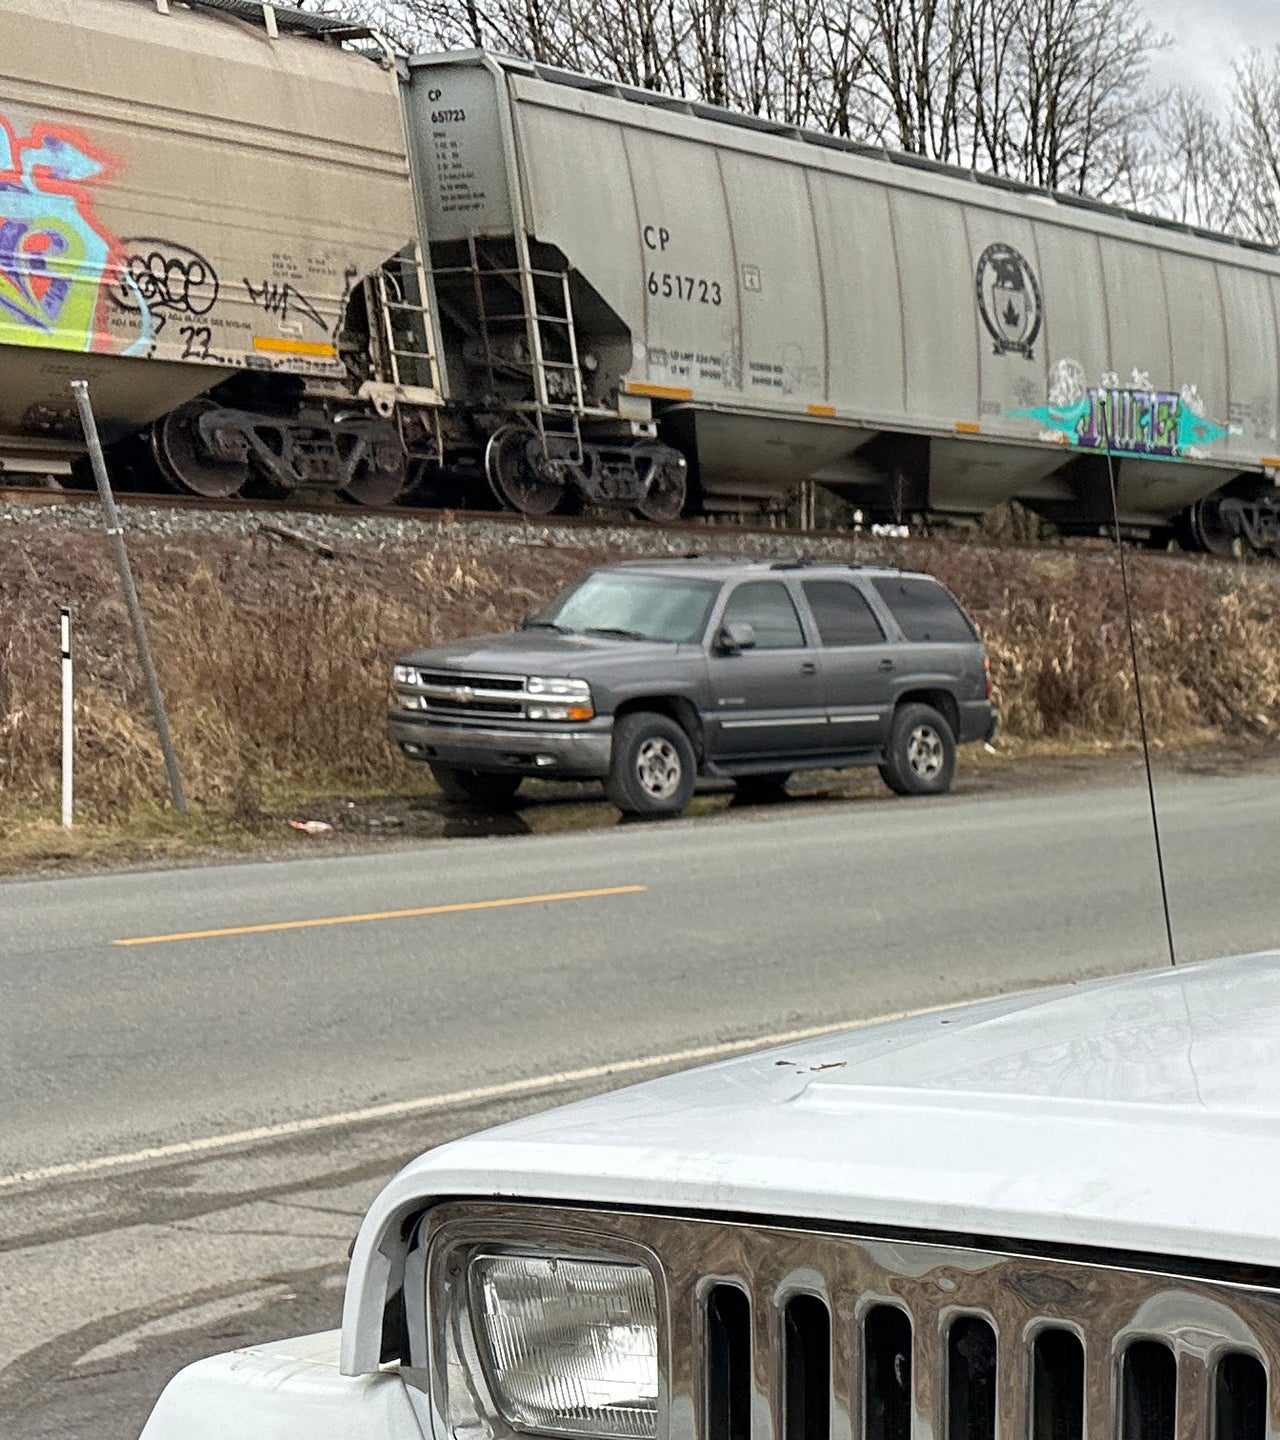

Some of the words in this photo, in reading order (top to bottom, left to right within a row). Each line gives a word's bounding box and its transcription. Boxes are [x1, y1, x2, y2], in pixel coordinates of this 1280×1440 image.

[428, 89, 441, 101] CP
[431, 109, 465, 123] 651723
[643, 225, 669, 250] CP
[648, 271, 722, 306] 651723
